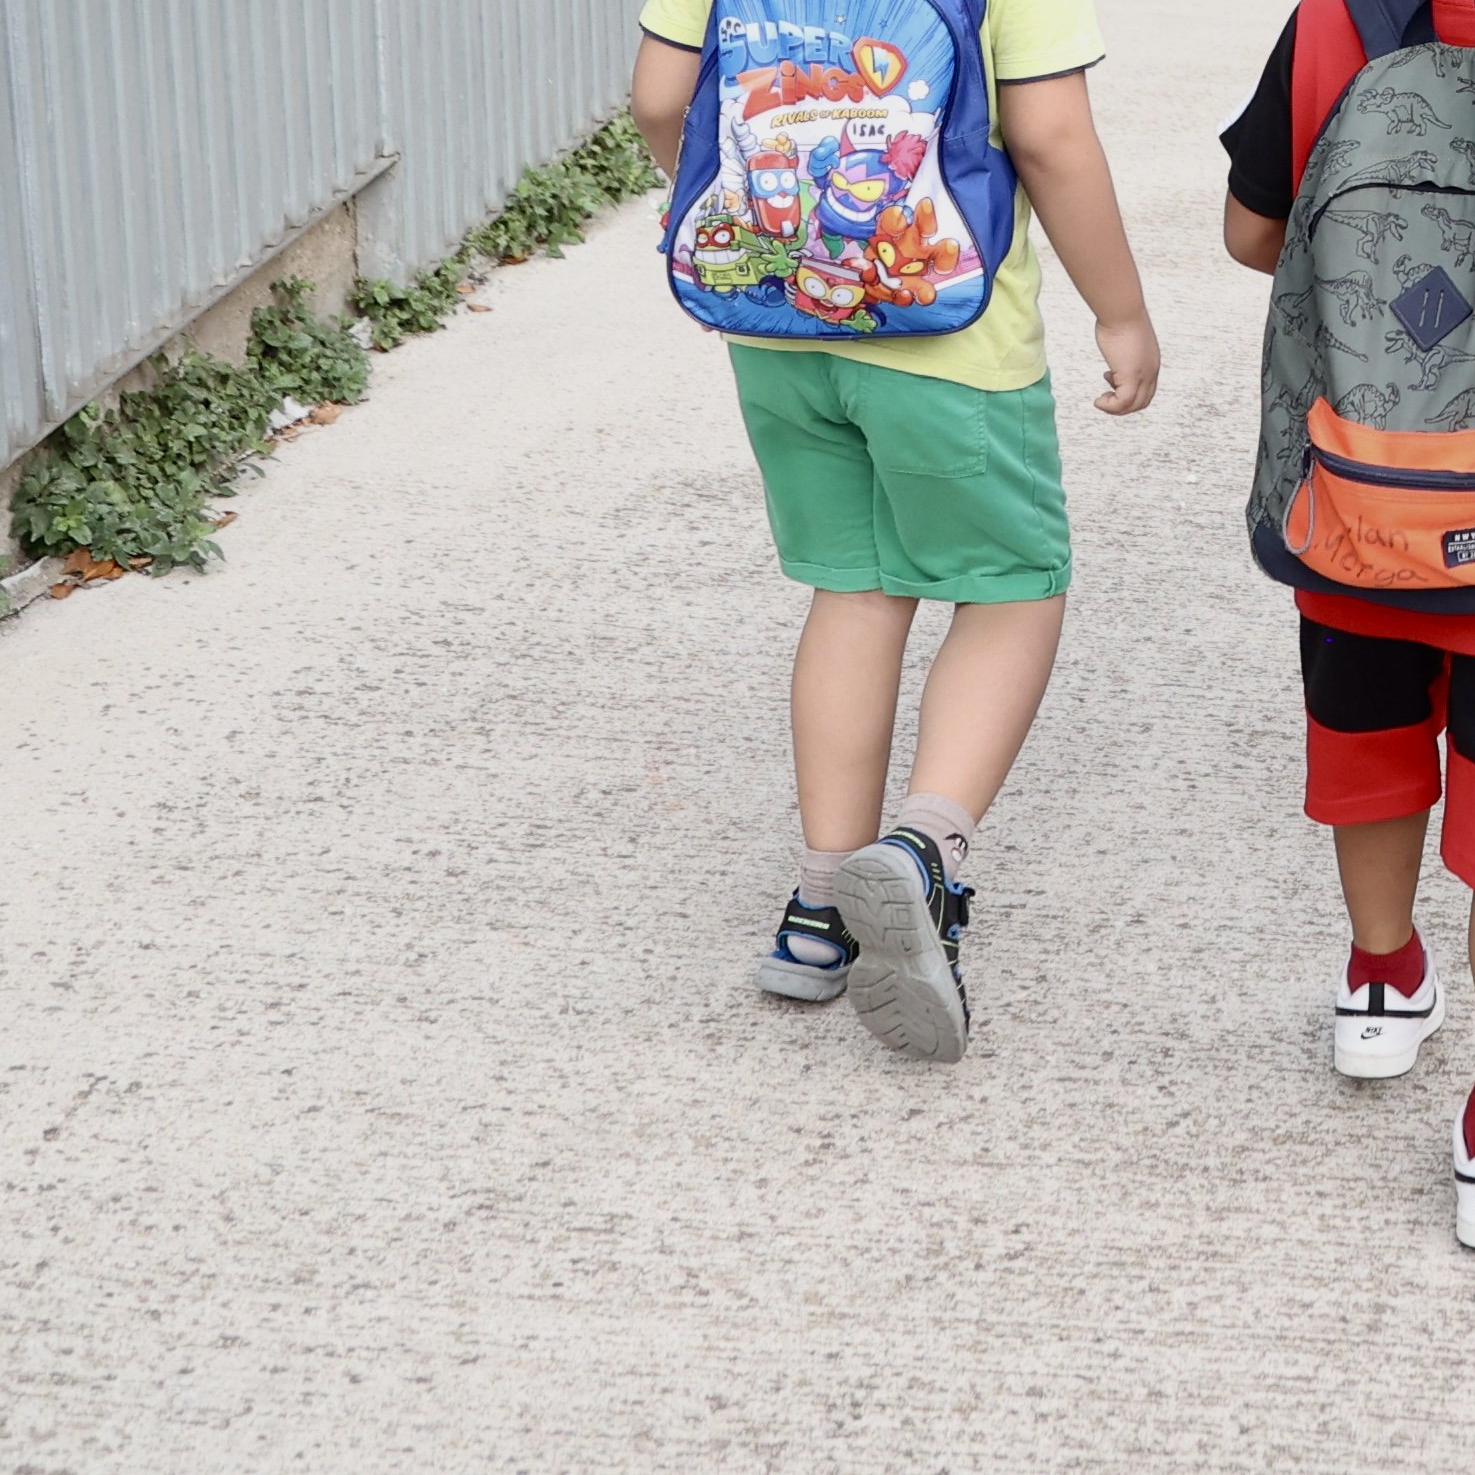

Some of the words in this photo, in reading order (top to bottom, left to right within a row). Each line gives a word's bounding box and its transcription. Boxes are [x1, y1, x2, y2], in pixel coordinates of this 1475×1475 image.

[719, 16, 853, 83] SUPER
[770, 109, 818, 129] RIVALS
[831, 108, 889, 121] KABOOM
